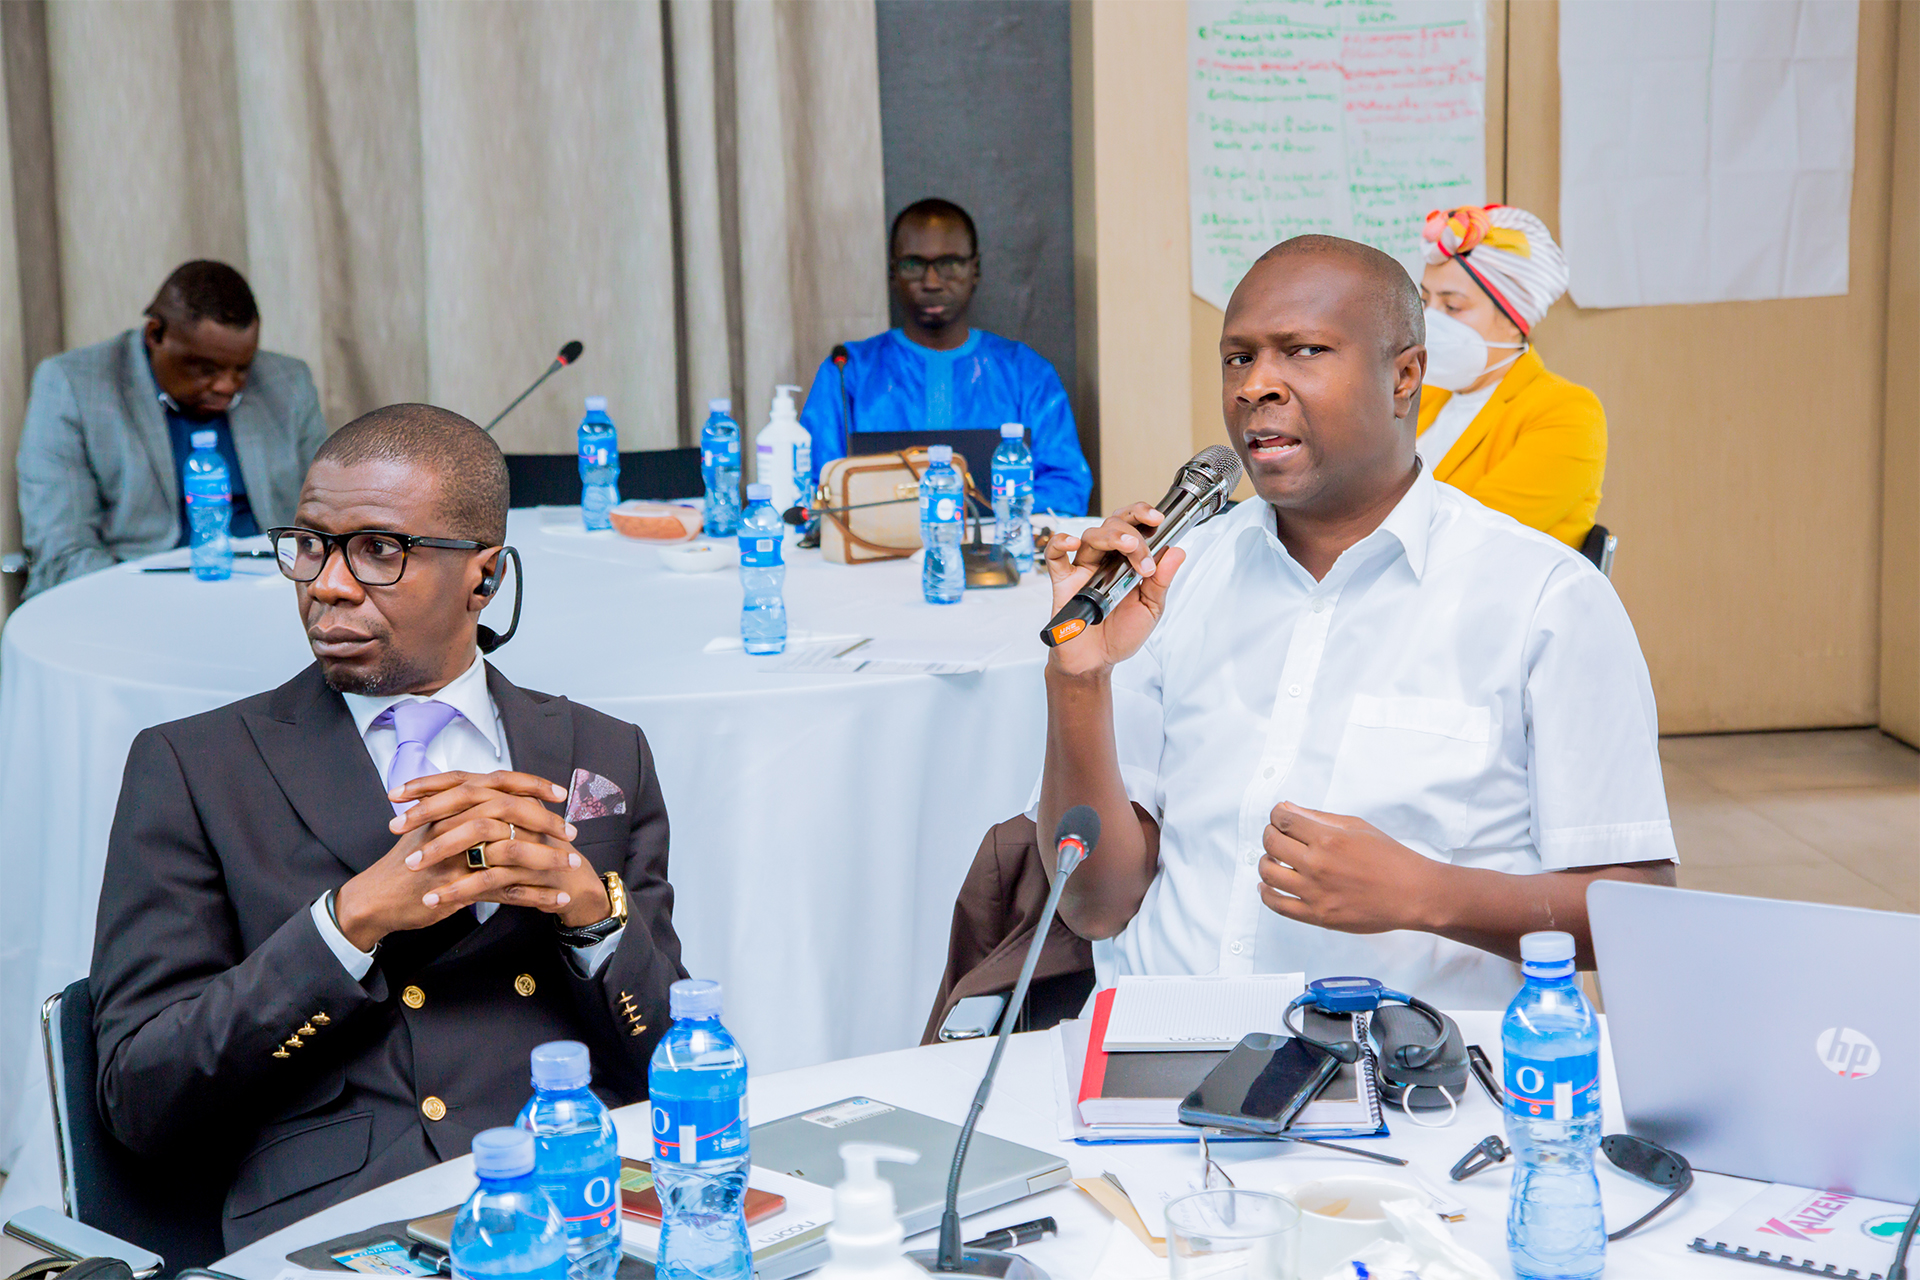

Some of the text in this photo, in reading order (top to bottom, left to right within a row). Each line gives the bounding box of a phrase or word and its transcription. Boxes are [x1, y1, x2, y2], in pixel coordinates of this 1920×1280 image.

[1827, 1027, 1873, 1080] hp
[1516, 1066, 1545, 1094] O
[652, 1107, 670, 1135] O
[584, 1177, 611, 1208] O
[1756, 1192, 1855, 1243] KAIZEN
